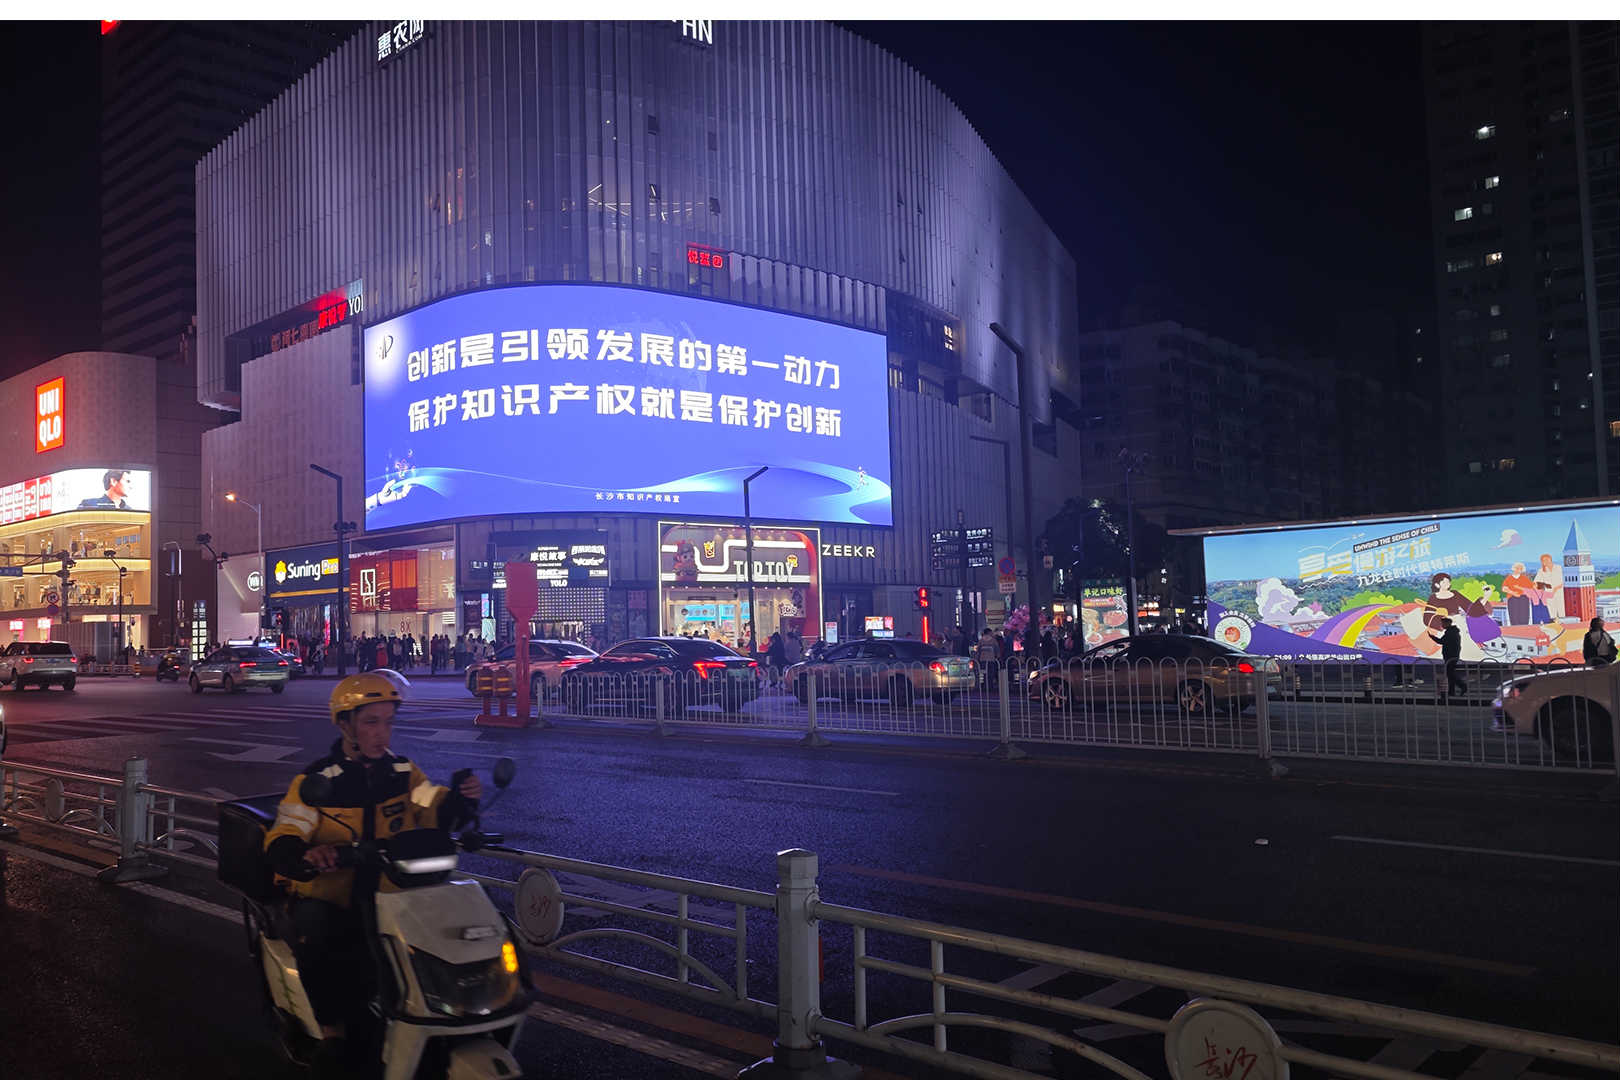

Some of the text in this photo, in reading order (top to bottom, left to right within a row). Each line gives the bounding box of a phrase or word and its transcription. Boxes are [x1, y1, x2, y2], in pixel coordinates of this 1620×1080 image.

[406, 328, 841, 390] 创新是引领发展的第一动力
[39, 386, 60, 416] UNI
[407, 382, 842, 438] 保护知识产权就是保护创新
[38, 416, 62, 448] QLO
[1391, 530, 1410, 543] SENSE
[1420, 523, 1439, 535] CHILL
[822, 544, 876, 558] ZEEKR
[287, 560, 321, 582] Suning
[766, 560, 795, 582] TOY
